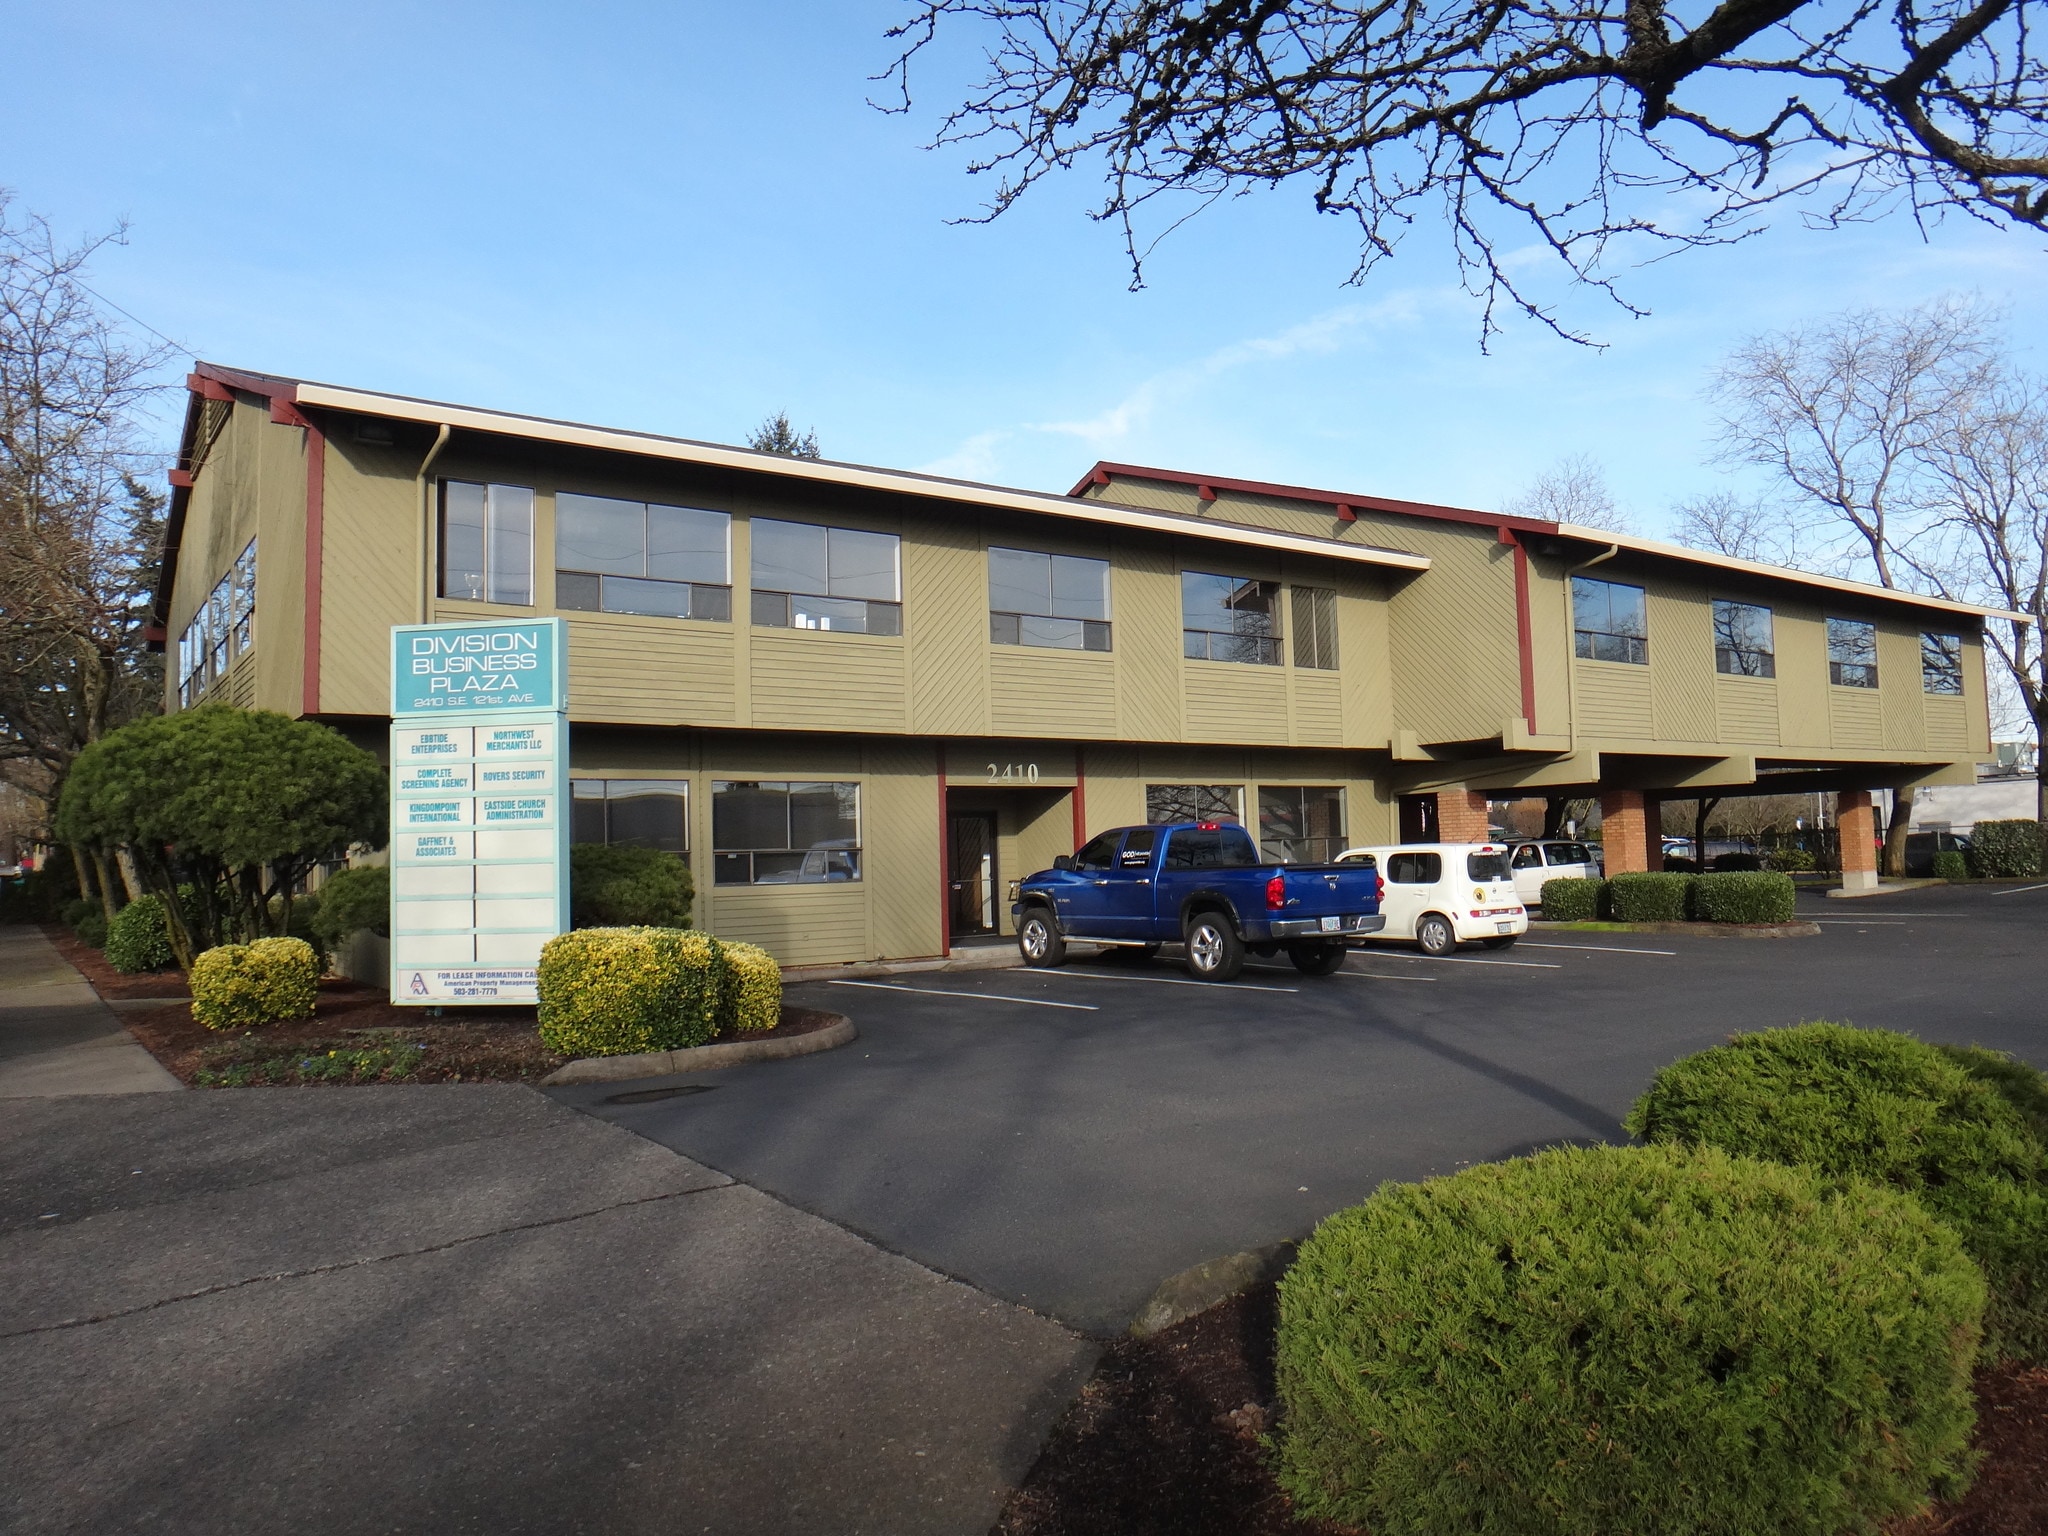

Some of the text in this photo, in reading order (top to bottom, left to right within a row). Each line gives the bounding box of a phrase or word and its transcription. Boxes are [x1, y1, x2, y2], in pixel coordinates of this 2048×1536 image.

[412, 632, 537, 656] DIVISION
[412, 653, 537, 675] BUSINESS
[431, 673, 519, 693] PLAZA
[414, 697, 444, 707] 2410
[420, 734, 448, 744] EBBTIDE
[493, 730, 534, 740] NORTHWEST
[411, 744, 458, 754] ENTERPRISES
[486, 739, 542, 751] MERCHANTS LLC
[417, 769, 452, 779] COMPLETE
[483, 770, 546, 781] ROVERS SECURITY
[986, 763, 1039, 784] 2410
[401, 778, 468, 789] SCREENING AGENCY
[409, 802, 461, 812] KINGDOMPOINT
[484, 799, 546, 810] EASTSIDE CHURCH
[409, 812, 461, 823] INTERNATIONAL
[486, 810, 544, 821] ADMINISTRATION
[417, 836, 454, 847] GAFFNEY &
[415, 846, 456, 857] ASSOCIATES
[437, 972, 451, 980] FOR
[475, 971, 523, 979] INFORMATION
